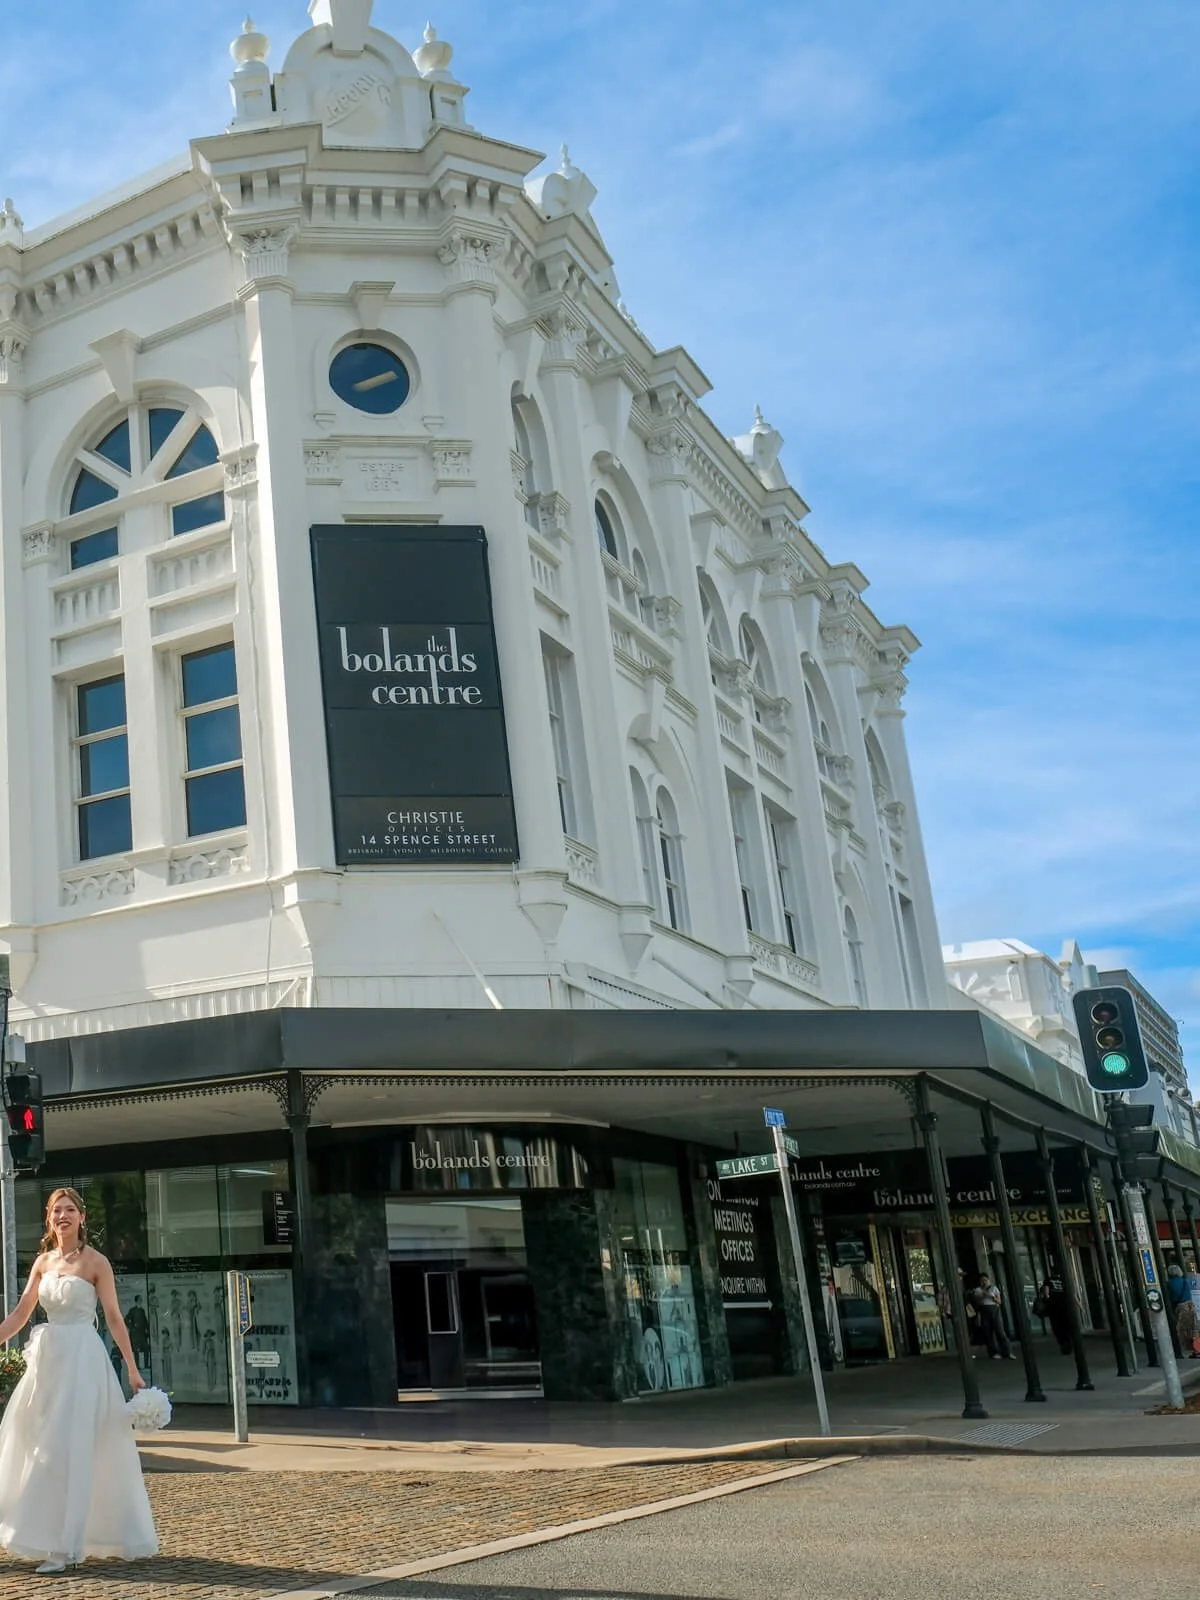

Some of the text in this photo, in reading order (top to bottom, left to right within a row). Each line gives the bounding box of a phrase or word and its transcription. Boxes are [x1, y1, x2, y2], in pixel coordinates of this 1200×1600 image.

[336, 626, 478, 673] bolands
[427, 635, 448, 653] the
[371, 671, 484, 705] centre
[387, 811, 465, 824] CHRISTIE
[361, 834, 496, 845] 14 SPENCE STREET
[408, 1139, 490, 1169] bolands
[496, 1146, 550, 1167] centre
[731, 1156, 768, 1175] LAKE ST
[836, 1162, 881, 1178] centre
[956, 1181, 1022, 1202] cente
[714, 1208, 754, 1233] MEETINGS
[721, 1238, 754, 1261] OFFICES
[745, 1276, 767, 1293] WITHIN
